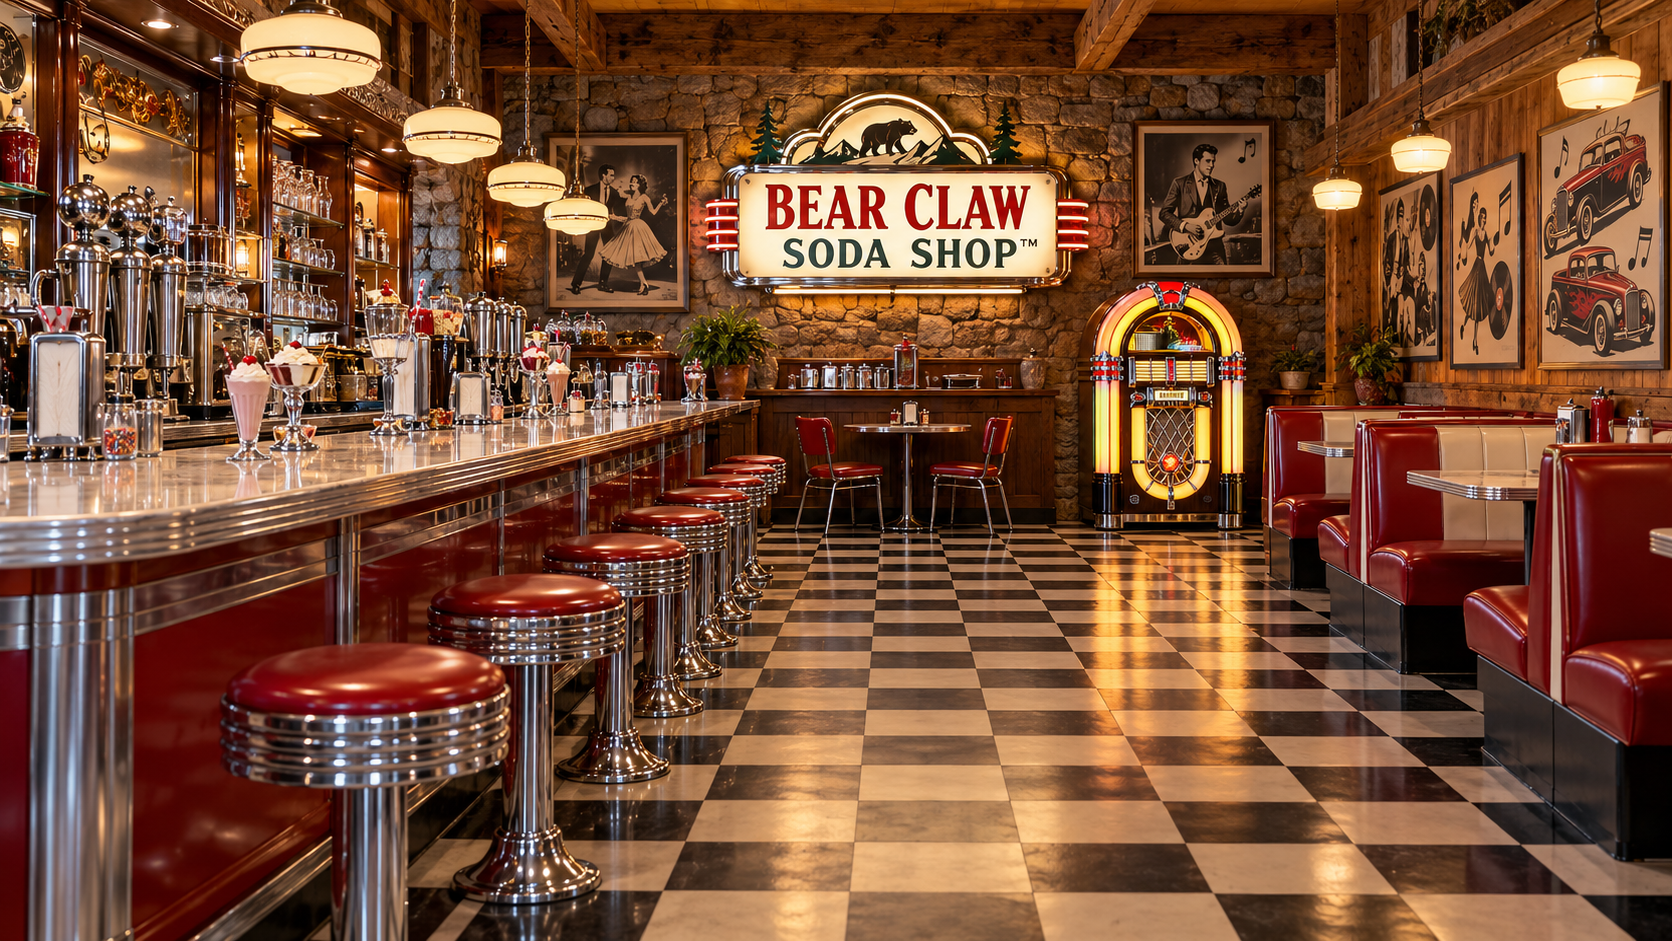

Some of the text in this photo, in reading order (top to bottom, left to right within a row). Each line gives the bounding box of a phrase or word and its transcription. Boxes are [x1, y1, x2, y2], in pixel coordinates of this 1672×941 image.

[765, 183, 1031, 230] BEAR CLAW
[783, 237, 891, 269] SODA
